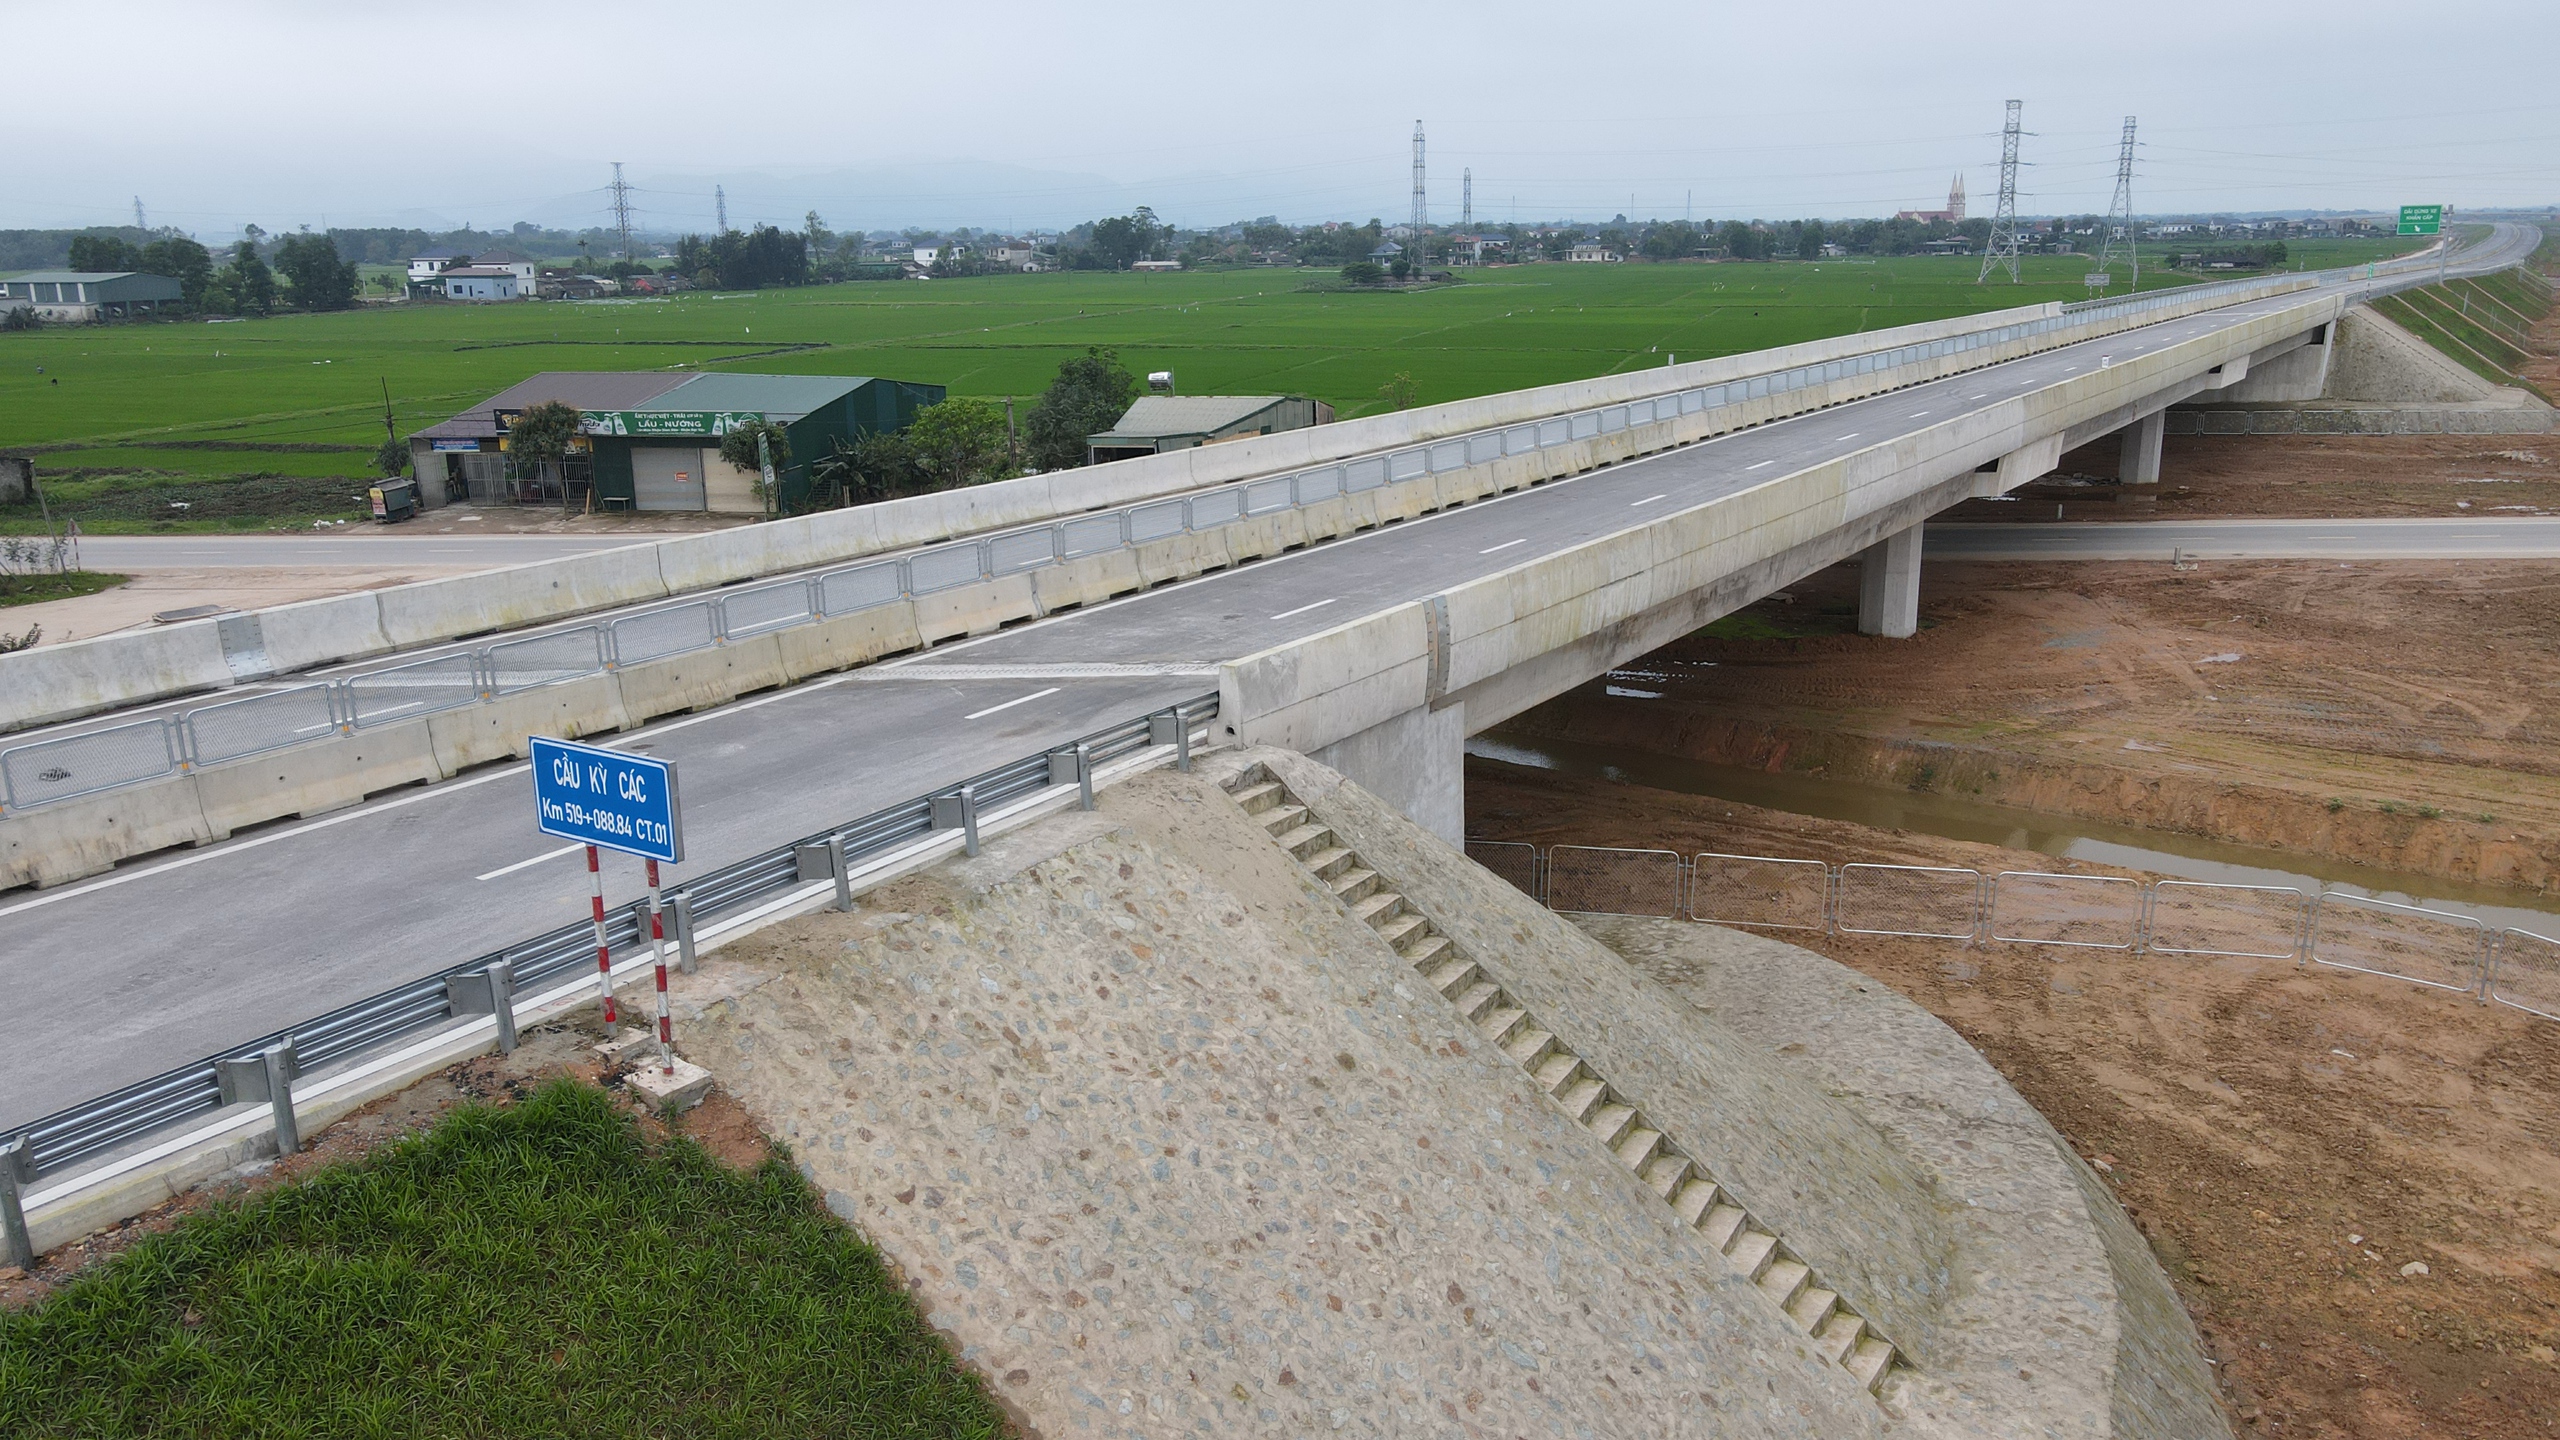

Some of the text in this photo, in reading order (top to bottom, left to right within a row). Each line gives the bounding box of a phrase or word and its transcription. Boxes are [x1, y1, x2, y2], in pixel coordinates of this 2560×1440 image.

[553, 751, 647, 803] CẦU KỲ CÁC
[542, 797, 668, 846] Km 519+088.84 CT.01
